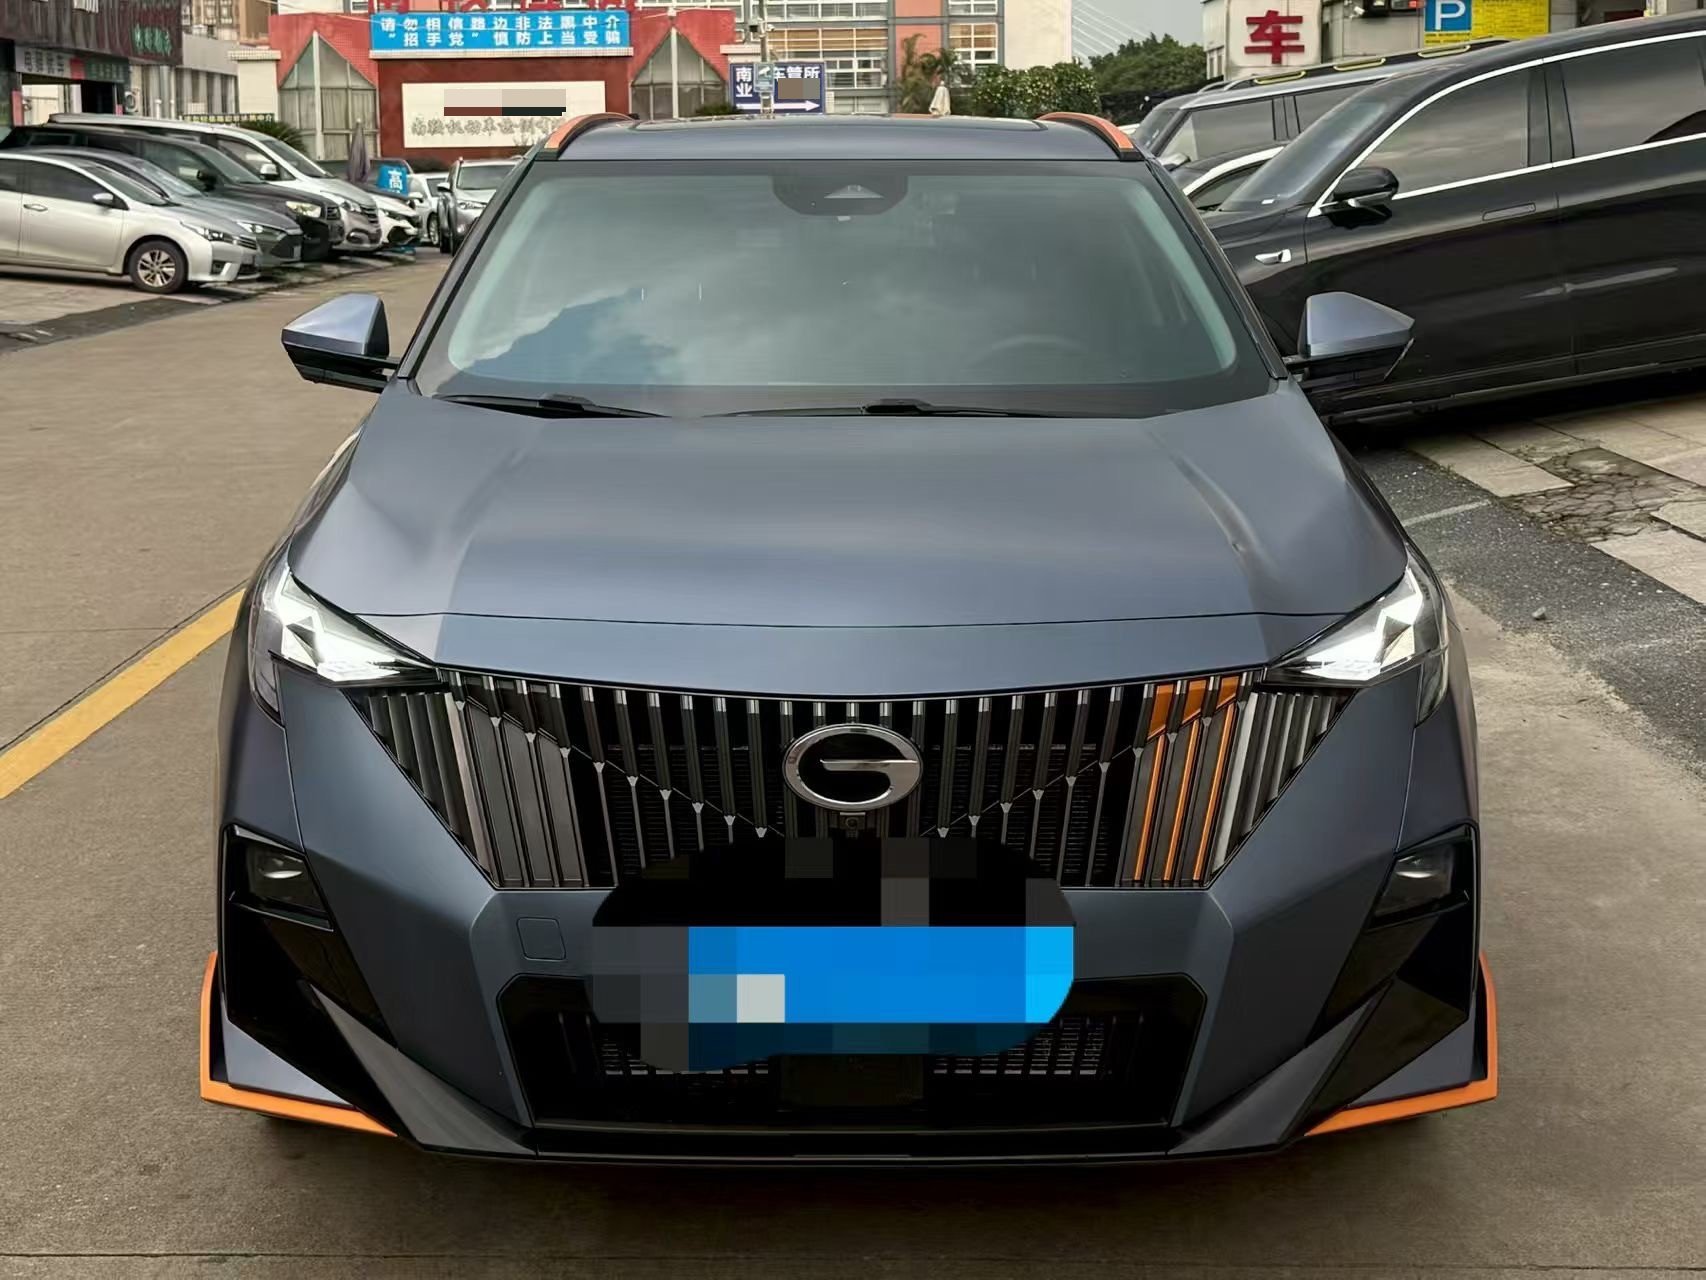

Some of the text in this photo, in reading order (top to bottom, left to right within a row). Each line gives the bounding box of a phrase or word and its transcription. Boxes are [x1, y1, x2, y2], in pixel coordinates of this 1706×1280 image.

[381, 15, 621, 32] 请勿相信路边非法黑中介
[1435, 0, 1466, 30] P
[1244, 10, 1305, 64] 车
[735, 66, 820, 82] 南车管所
[387, 168, 403, 193] 高
